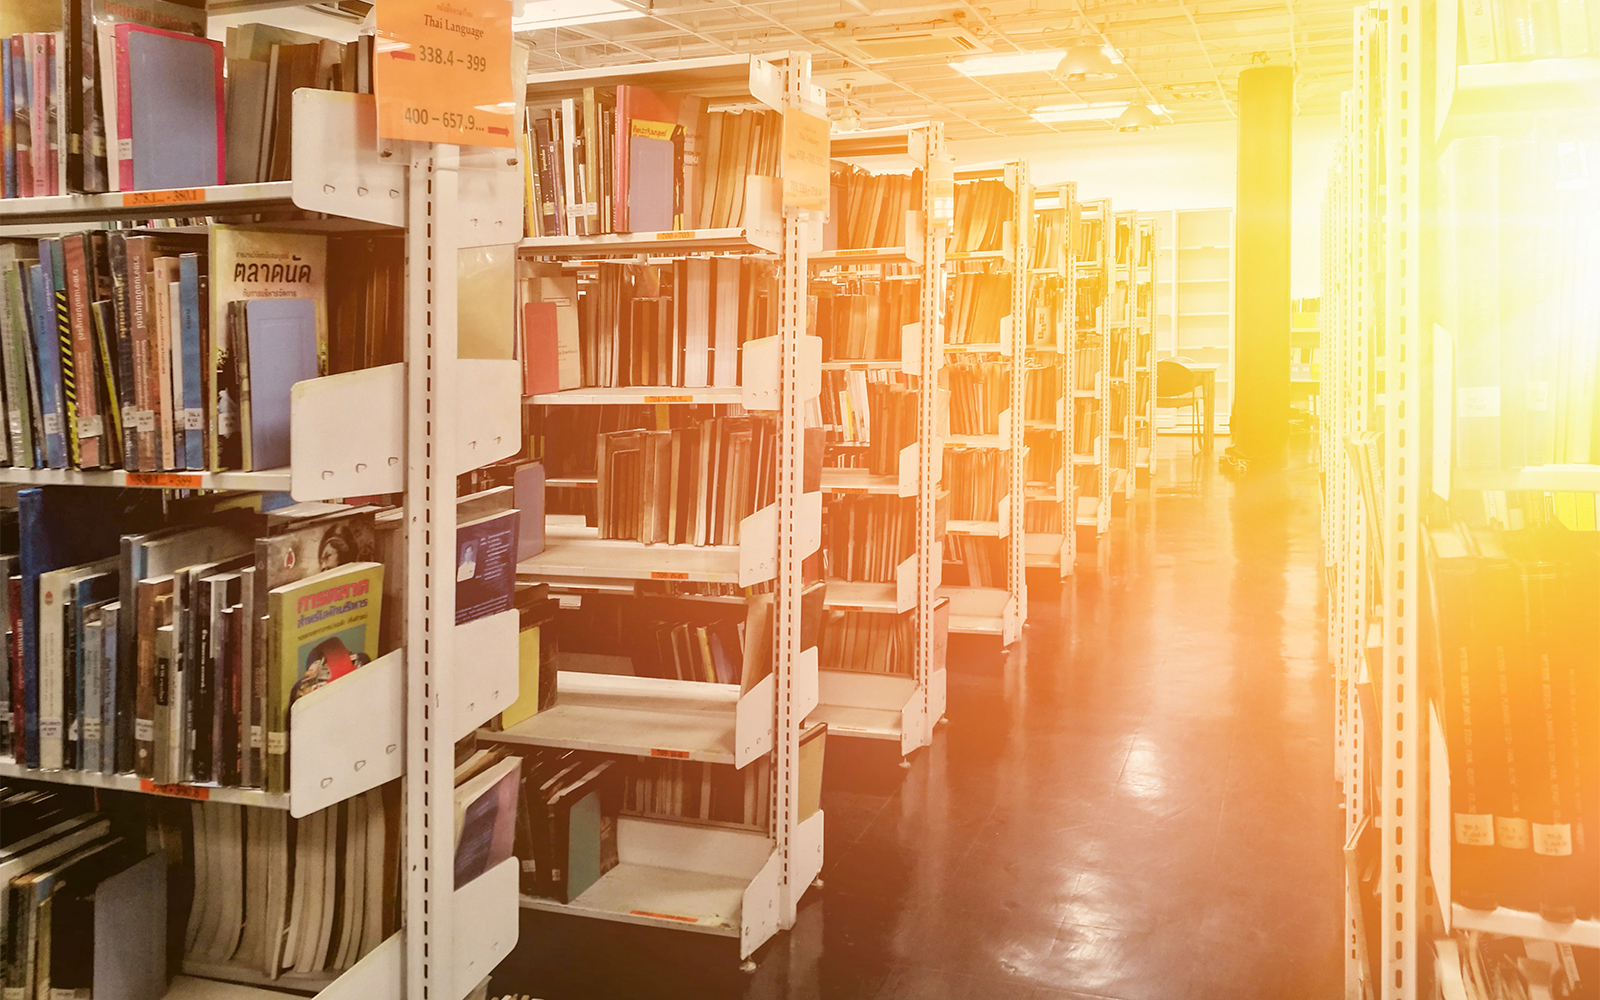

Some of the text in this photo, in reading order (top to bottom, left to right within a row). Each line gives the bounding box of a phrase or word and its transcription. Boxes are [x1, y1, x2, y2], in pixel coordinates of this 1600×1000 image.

[423, 13, 484, 41] Thai Language
[419, 45, 454, 66] 338.4
[466, 54, 487, 72] 399
[404, 107, 429, 125] 400
[233, 254, 312, 283] ตลาดนัด
[297, 579, 369, 614] การตลาด
